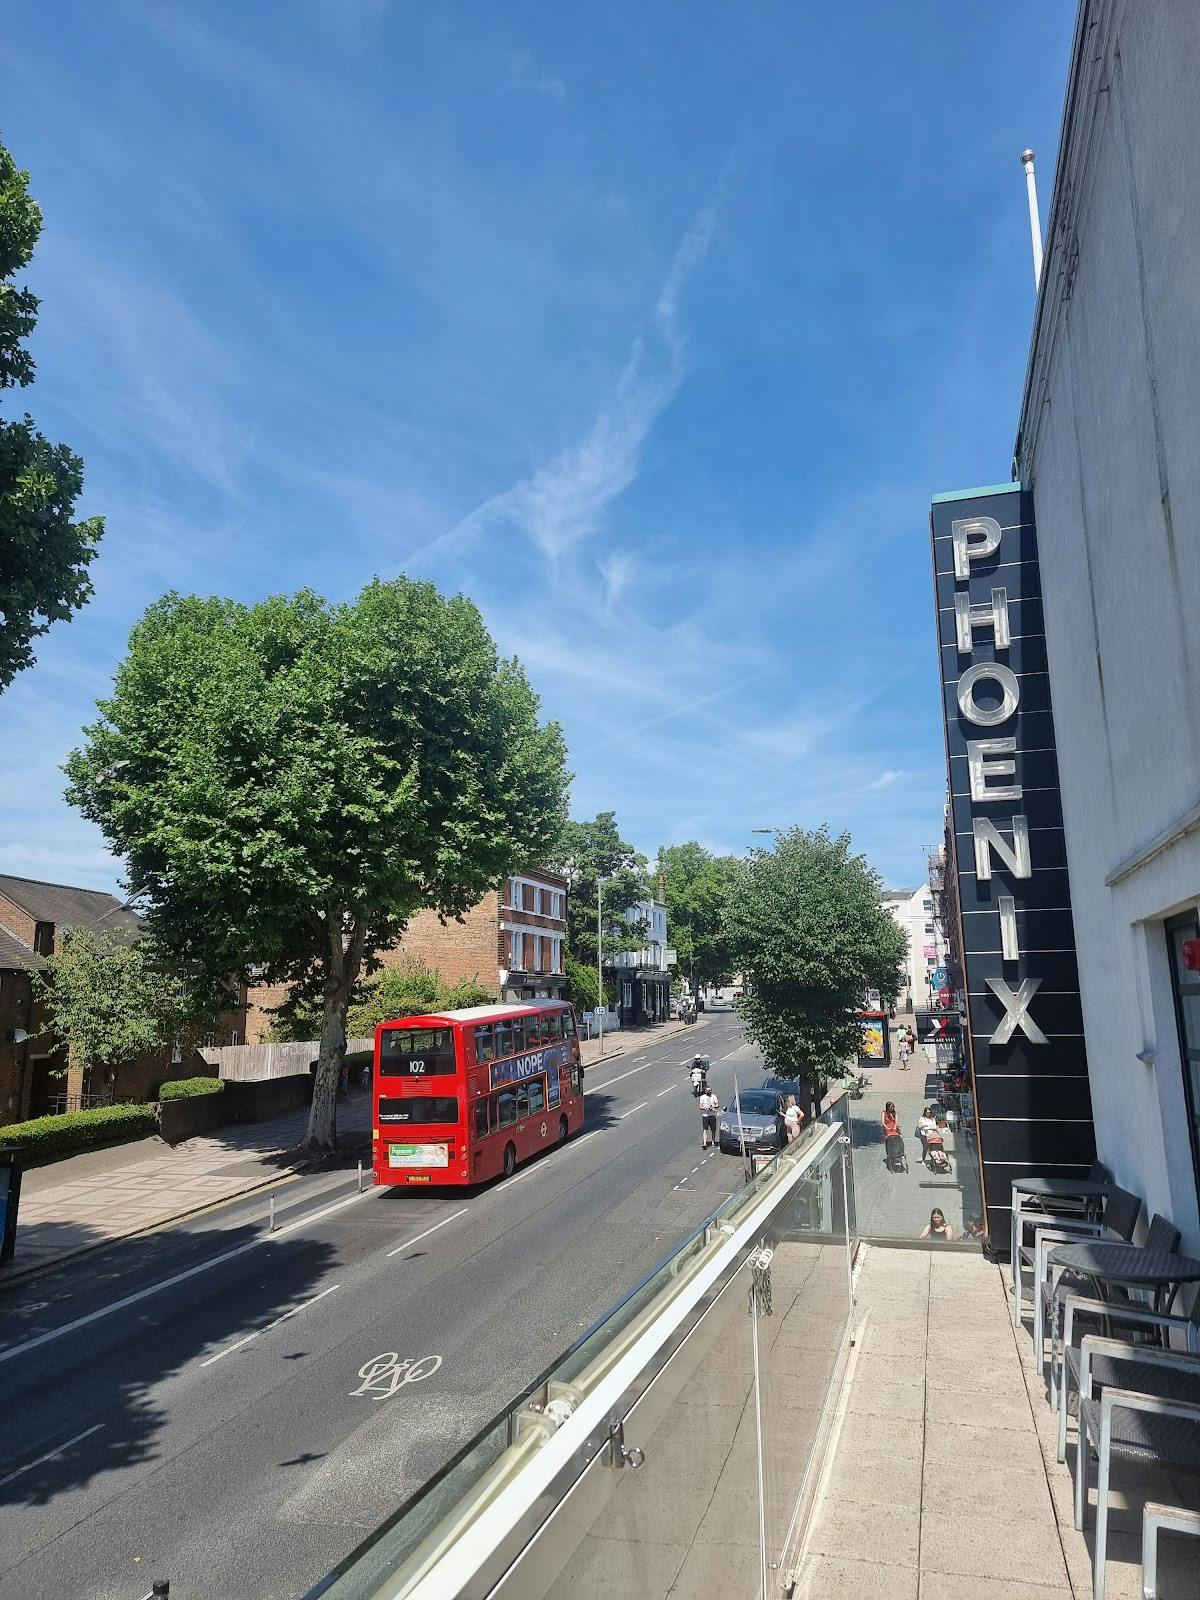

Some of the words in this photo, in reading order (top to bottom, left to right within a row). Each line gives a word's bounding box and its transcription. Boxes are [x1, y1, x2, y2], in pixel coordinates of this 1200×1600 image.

[951, 516, 1050, 1046] PHOENIX
[409, 1060, 425, 1073] 102
[517, 1053, 543, 1078] NOPE
